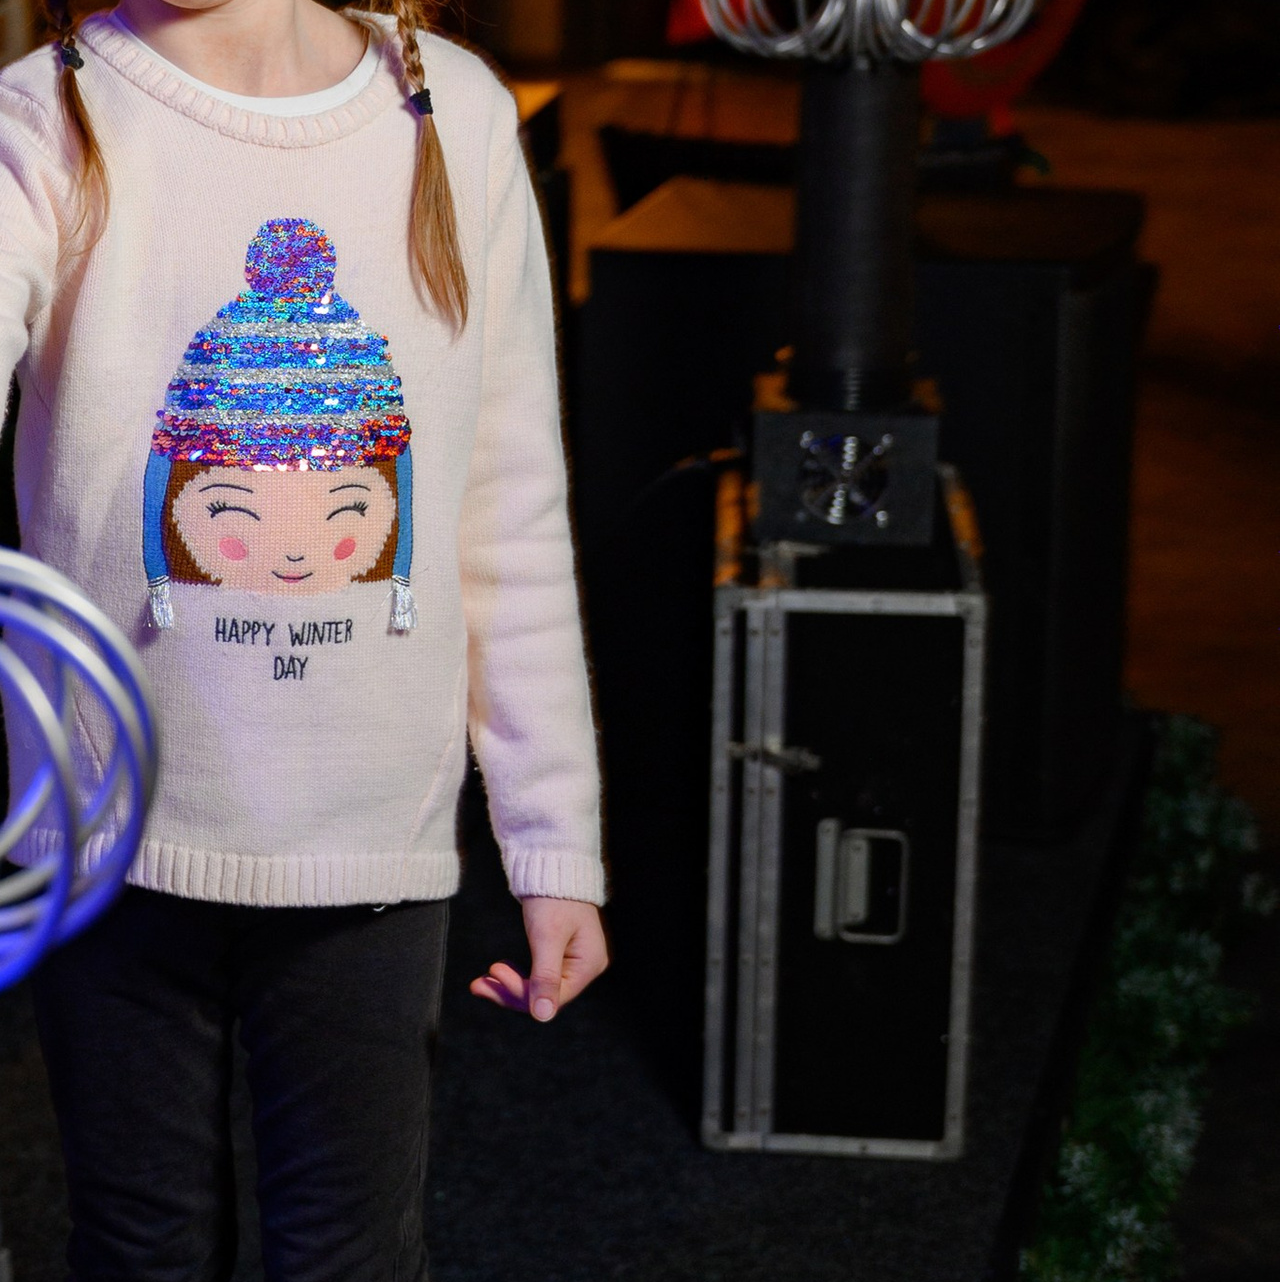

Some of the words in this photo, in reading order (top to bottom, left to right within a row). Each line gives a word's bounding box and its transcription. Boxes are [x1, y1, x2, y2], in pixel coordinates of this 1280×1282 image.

[215, 617, 275, 647] HAPPY
[288, 619, 354, 648] WINTER
[273, 655, 308, 681] DAY
